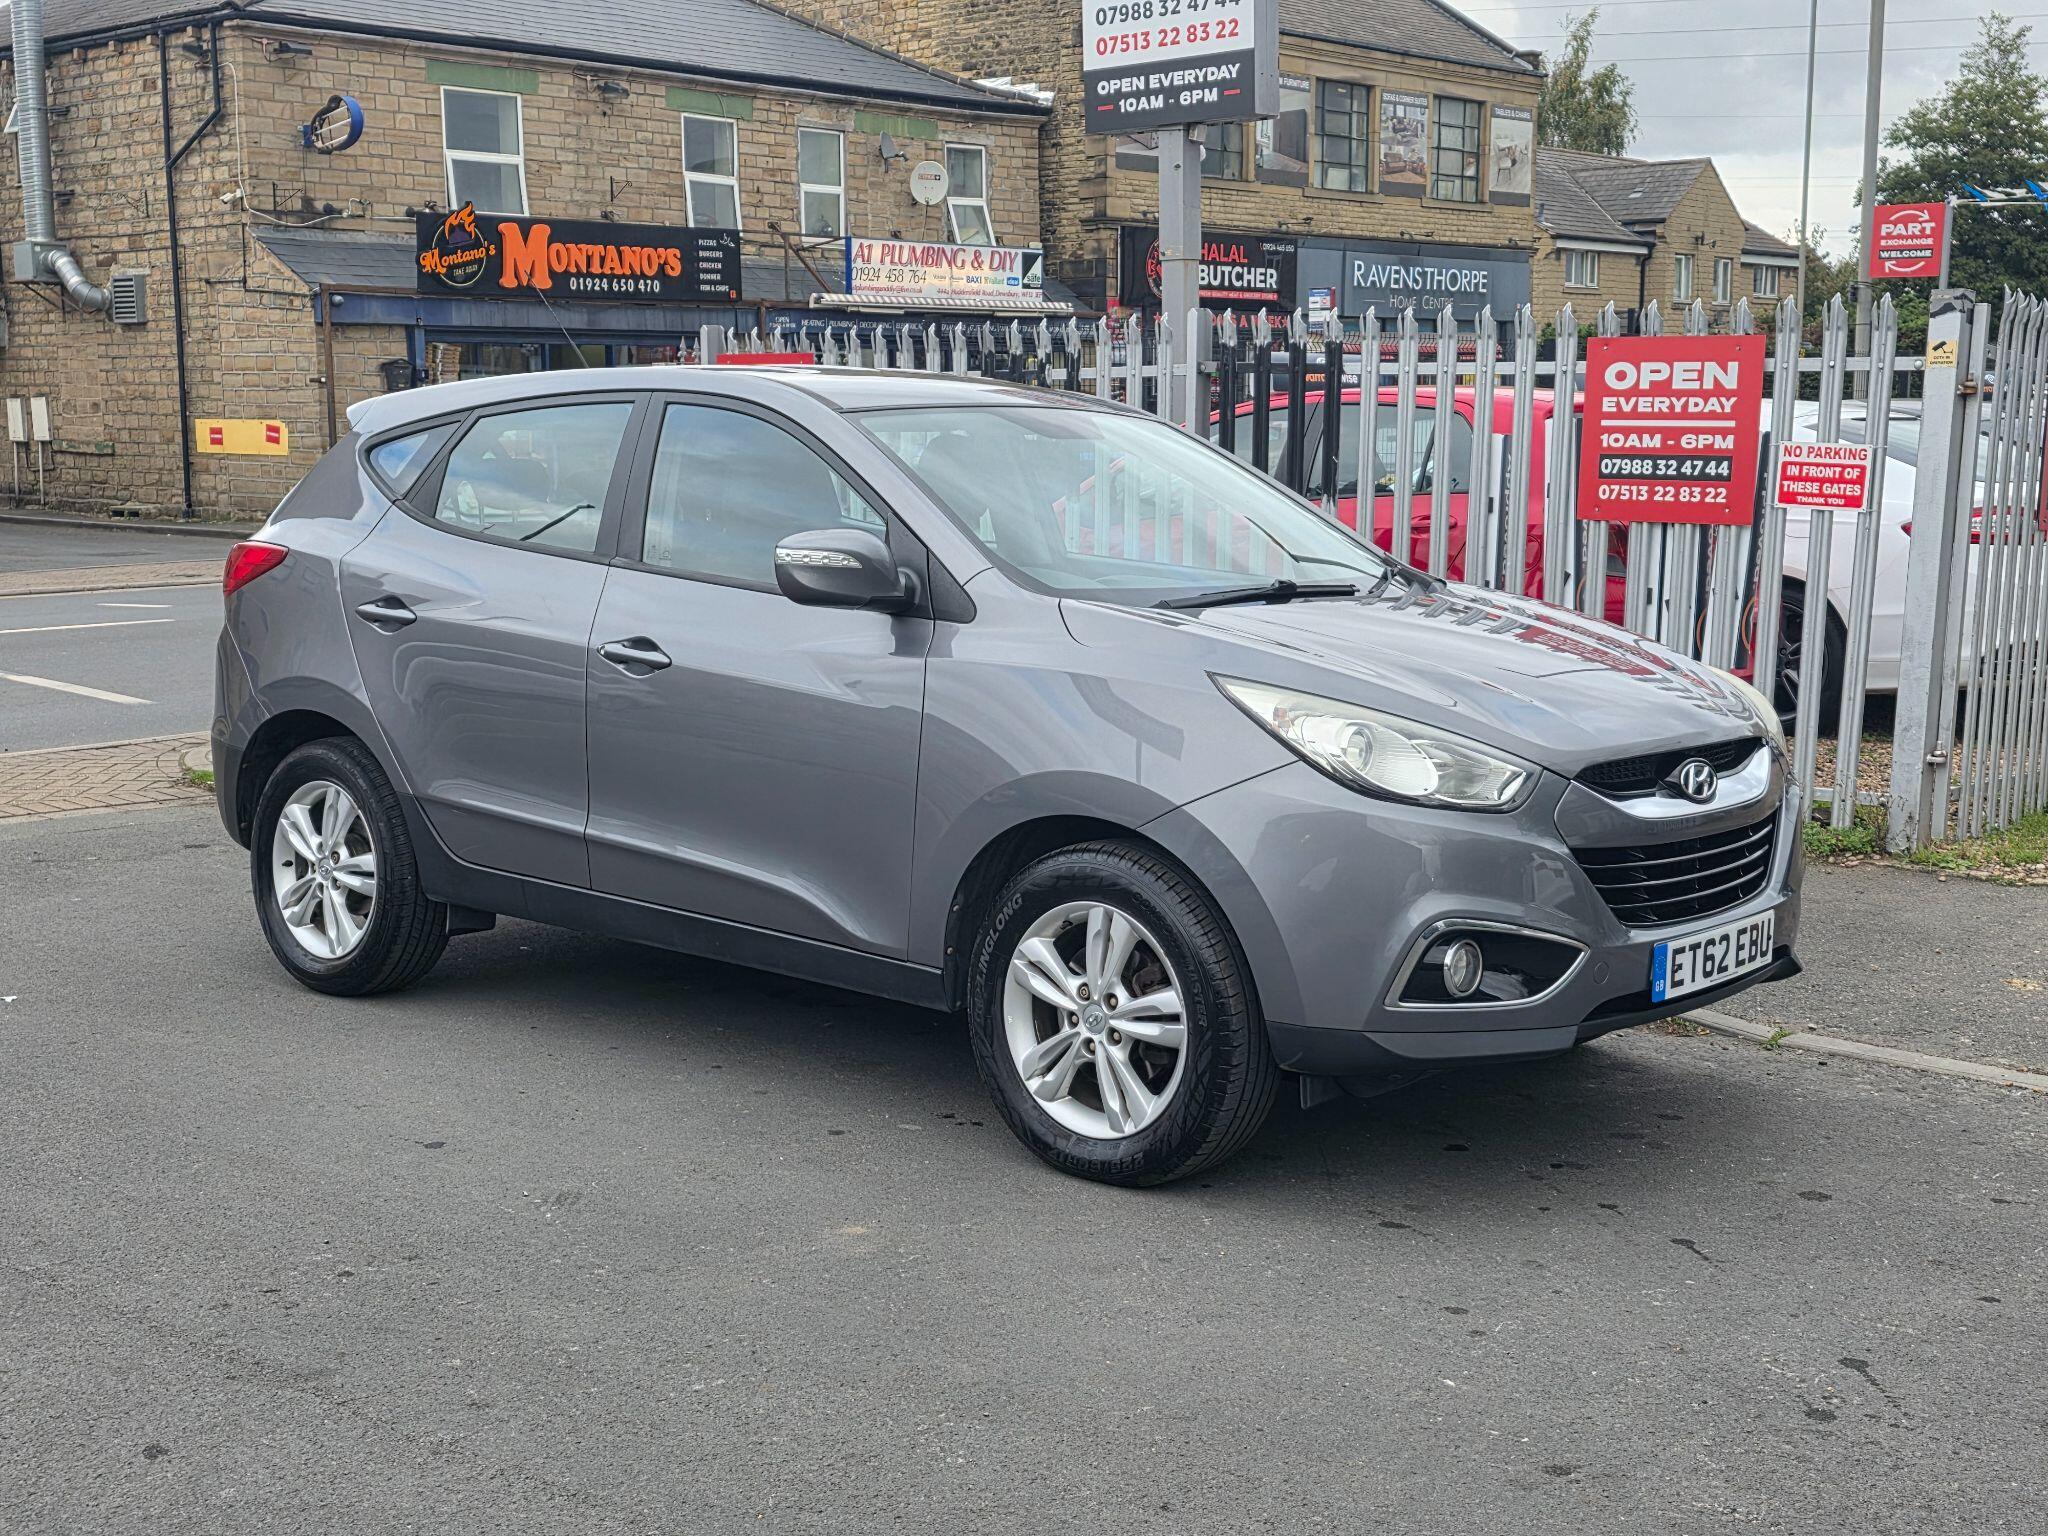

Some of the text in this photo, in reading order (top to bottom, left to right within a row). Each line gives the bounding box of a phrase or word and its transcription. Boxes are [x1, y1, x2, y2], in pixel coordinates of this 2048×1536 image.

[1095, 1, 1153, 25] 07988
[1158, 0, 1180, 17] 32
[1095, 17, 1239, 56] 07513 22 83 22
[1097, 63, 1241, 96] OPEN EVERYDAY
[1118, 95, 1164, 113] 10AM
[1179, 88, 1218, 106] 6PM
[1880, 222, 1936, 237] PART
[1880, 237, 1934, 246] EXCHANGE
[420, 240, 496, 274] Montano's
[498, 222, 681, 290] MONTANO'S
[853, 241, 1019, 272] A1 PLUMBING & DIY
[1880, 249, 1932, 258] WELCOME
[699, 261, 722, 269] CHICKEN
[851, 266, 927, 284] 01924 458 764
[966, 275, 982, 284] BAXI
[1027, 274, 1040, 283] safe
[1199, 264, 1278, 289] BUTCHER
[1353, 260, 1488, 293] RAVENSTHORPE
[570, 277, 660, 293] 01924 650 470
[1389, 295, 1417, 309] HOME
[801, 319, 825, 327] HEATING
[1604, 361, 1739, 390] OPEN
[1602, 396, 1738, 414] EVERYDAY
[1600, 433, 1661, 449] 10AM
[1680, 434, 1734, 449] 6PM
[1783, 445, 1869, 461] NO PARKING
[1601, 458, 1730, 477] 07988 32 47 44
[1787, 464, 1861, 479] IN FRONT OF
[1599, 484, 1727, 503] 07513 22 83 22
[1782, 481, 1861, 496] THESE GATES
[1796, 495, 1845, 505] THANK YOU
[976, 893, 1023, 986] LINGLONG
[1670, 918, 1772, 989] ET62 EBU
[1655, 980, 1664, 992] GB
